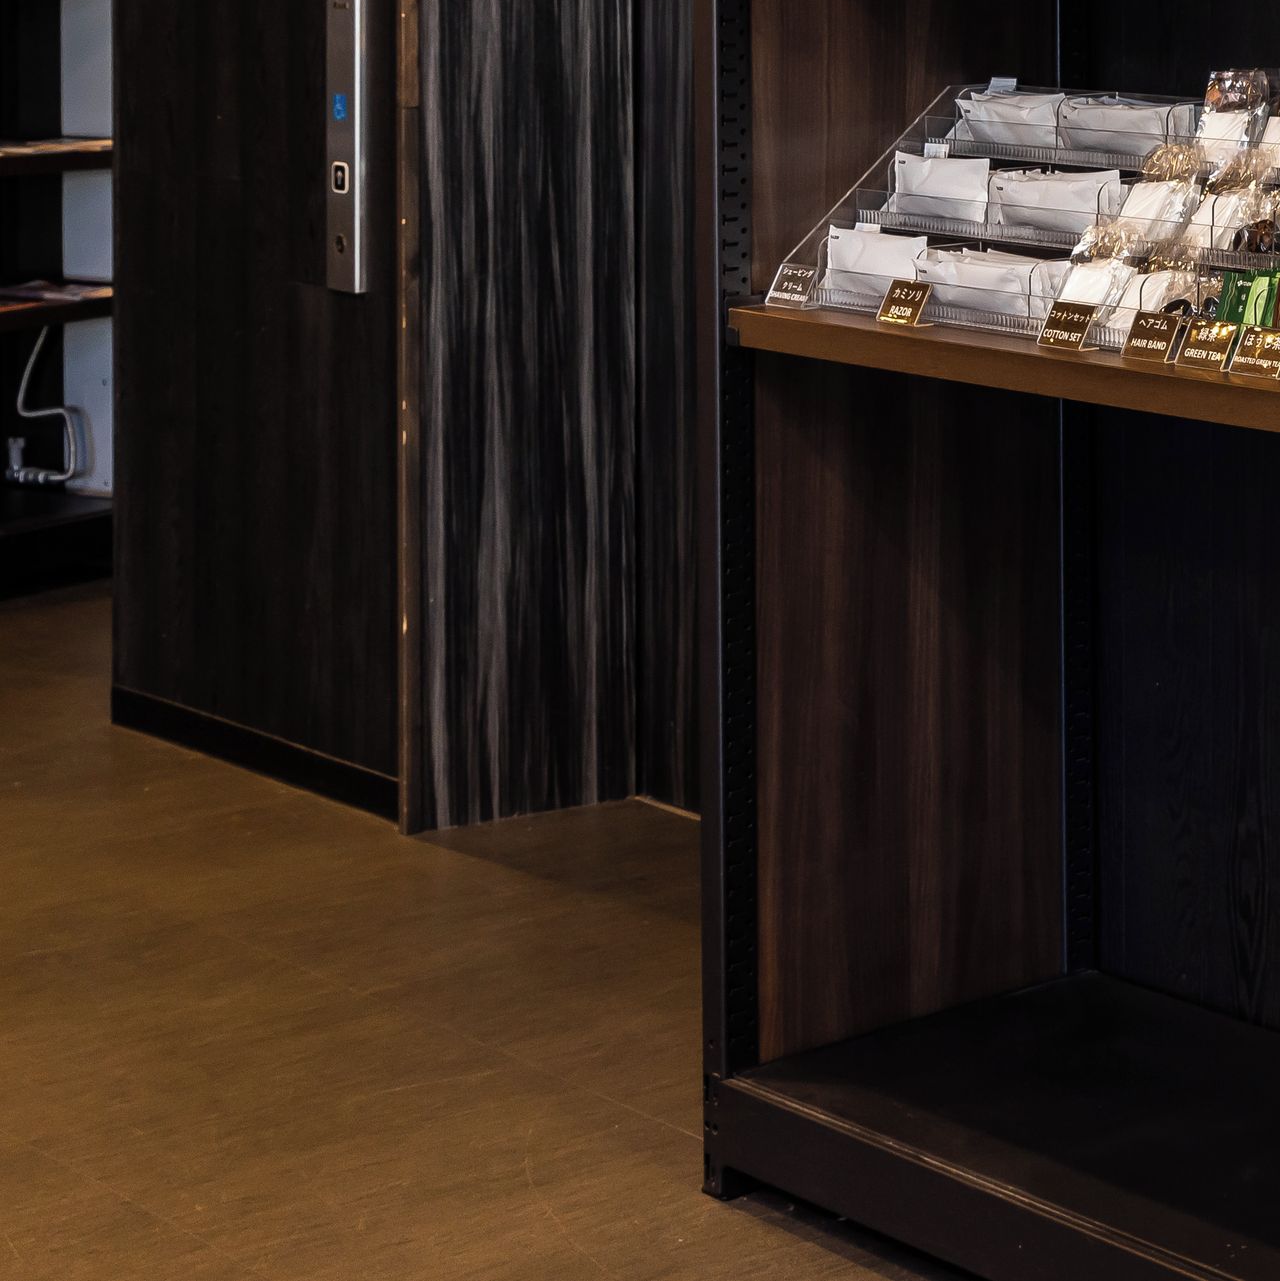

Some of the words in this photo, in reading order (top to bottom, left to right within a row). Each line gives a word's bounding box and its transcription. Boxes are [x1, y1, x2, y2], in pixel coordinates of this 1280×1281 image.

[783, 267, 814, 278] シェービング
[782, 281, 803, 291] クリーム
[769, 291, 791, 300] SHAVING
[892, 288, 923, 302] カミソリ
[889, 305, 912, 317] RAZOR
[1050, 310, 1091, 323] コットンセット
[1139, 319, 1168, 330] ヘアゴム
[1043, 329, 1068, 340] COTTON
[1068, 331, 1082, 342] SET
[1198, 327, 1217, 342] 緑茶
[1131, 338, 1147, 348] HAIR
[1147, 340, 1167, 350] BAND
[1184, 348, 1207, 359] GREEN
[1208, 351, 1221, 361] TEA
